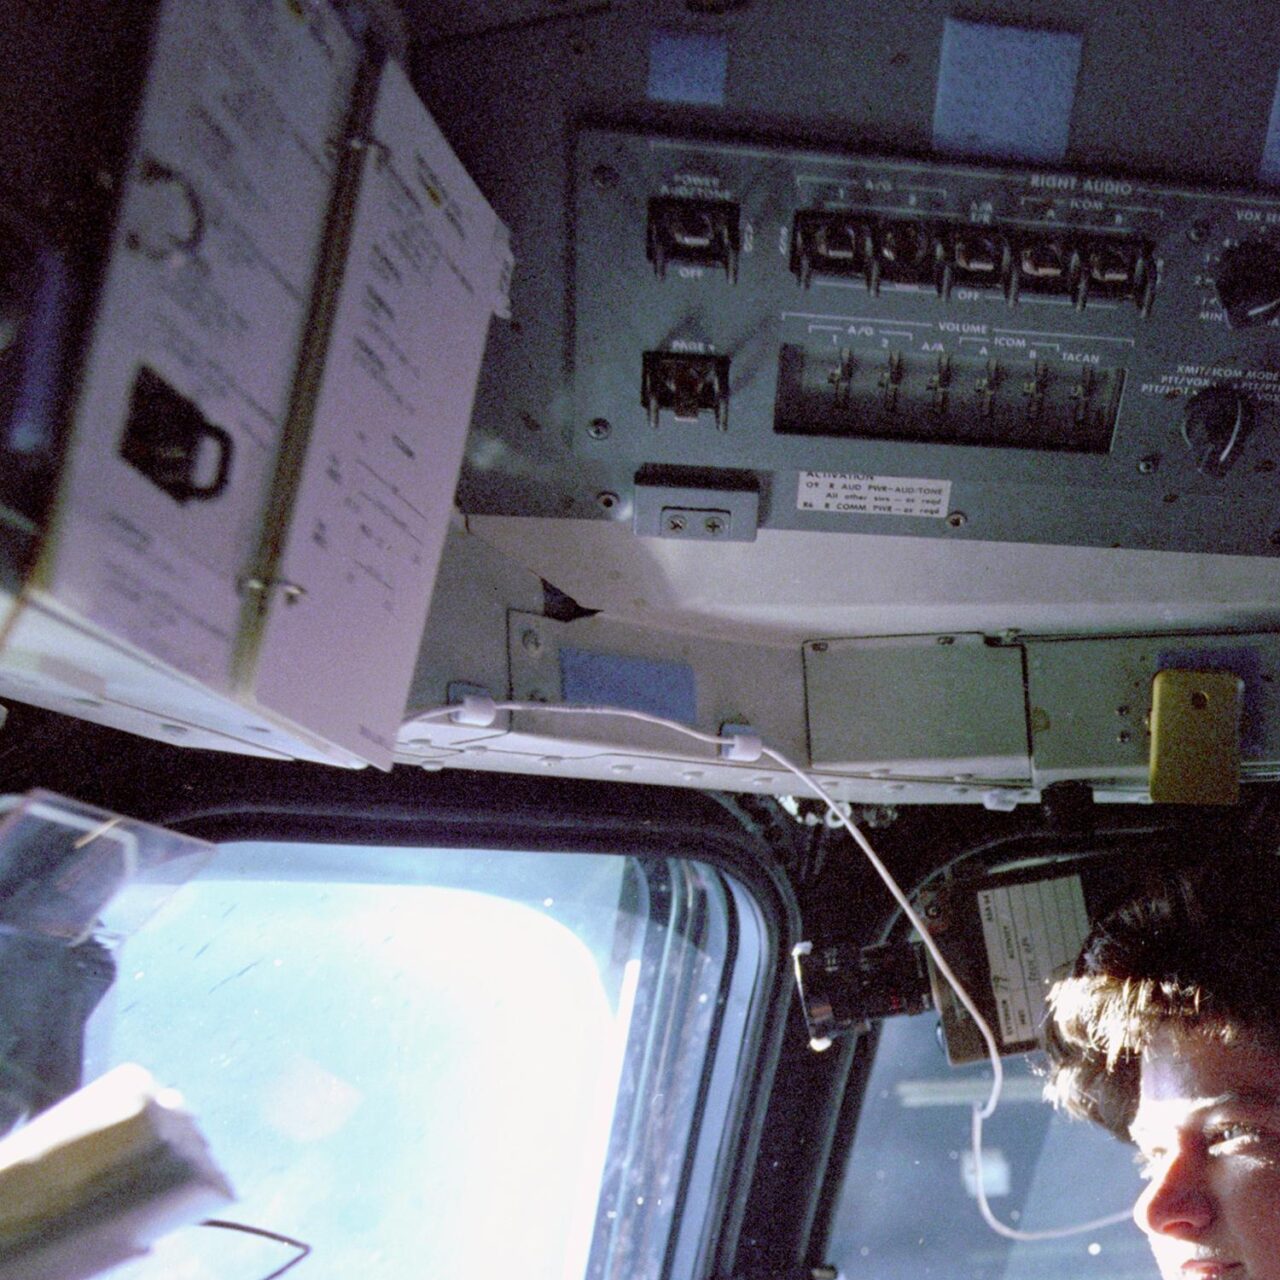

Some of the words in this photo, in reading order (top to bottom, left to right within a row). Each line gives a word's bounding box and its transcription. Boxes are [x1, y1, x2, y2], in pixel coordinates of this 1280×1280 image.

[1082, 178, 1133, 196] AUDIO
[1236, 209, 1262, 221] VOX
[958, 290, 980, 301] OFF
[1200, 311, 1223, 322] MIN
[847, 324, 874, 338] A/G
[938, 321, 988, 335] VOLUME
[832, 334, 838, 345] 1
[993, 336, 1026, 349] ICOM
[921, 341, 944, 353] A/A
[979, 345, 988, 357] A
[1062, 352, 1100, 364] TACAN
[1176, 364, 1243, 378] XMIT/ICOM
[1246, 370, 1279, 382] MODE
[1160, 375, 1211, 387] PTT/VOX
[841, 483, 862, 491] AUD
[826, 491, 839, 499] All
[844, 493, 868, 501] other
[836, 502, 867, 511] COMM
[872, 504, 893, 513] PWR
[919, 507, 940, 515] reqd
[1002, 925, 1015, 960] ACTIVITY
[1001, 999, 1013, 1036] EXTERIOR
